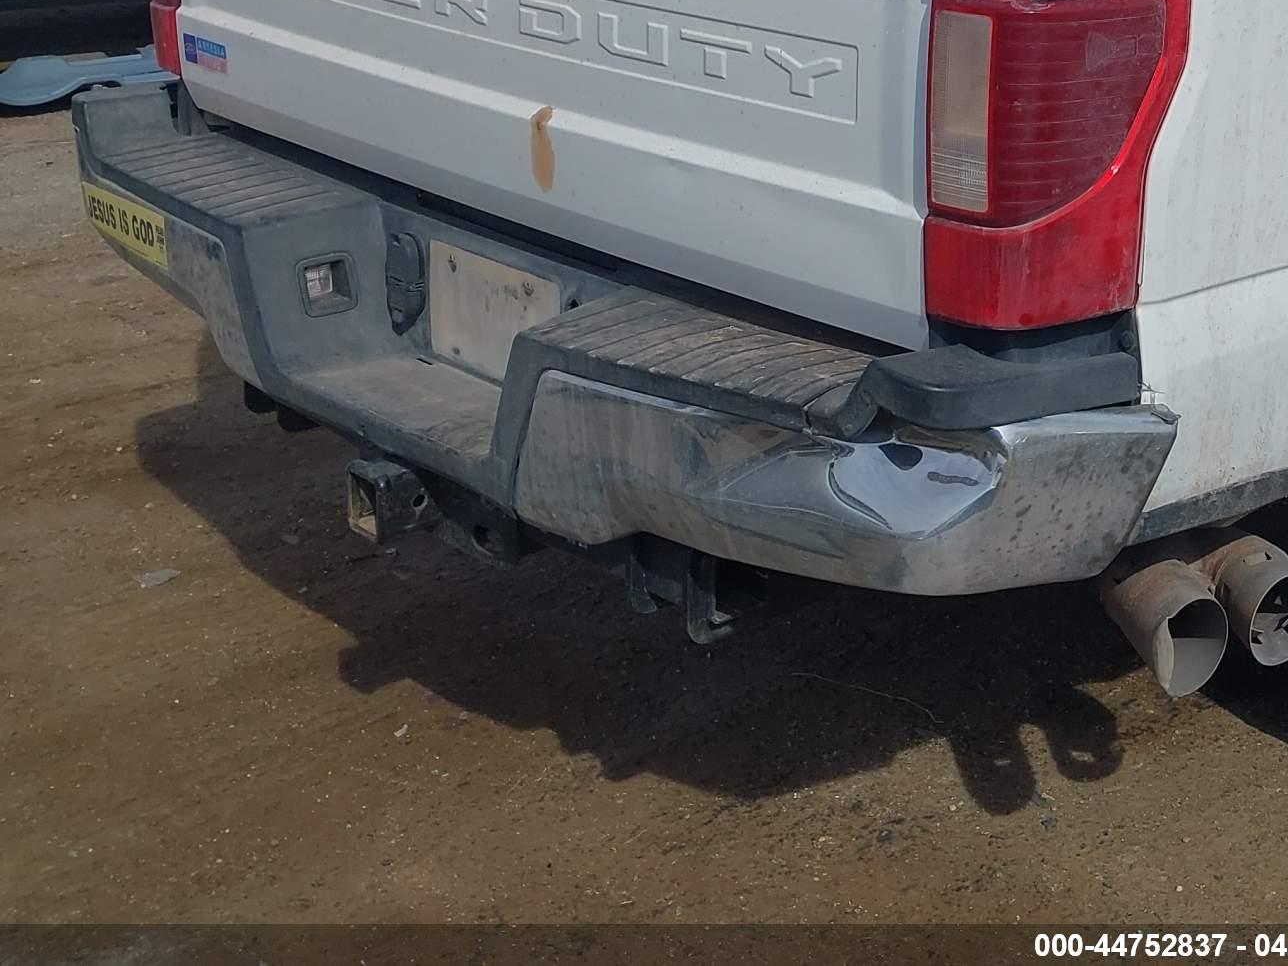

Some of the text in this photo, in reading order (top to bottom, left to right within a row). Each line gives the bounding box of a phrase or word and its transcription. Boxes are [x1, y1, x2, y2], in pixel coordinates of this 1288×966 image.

[88, 194, 117, 230] JESUS
[118, 207, 130, 236] IS
[131, 215, 155, 247] GOD
